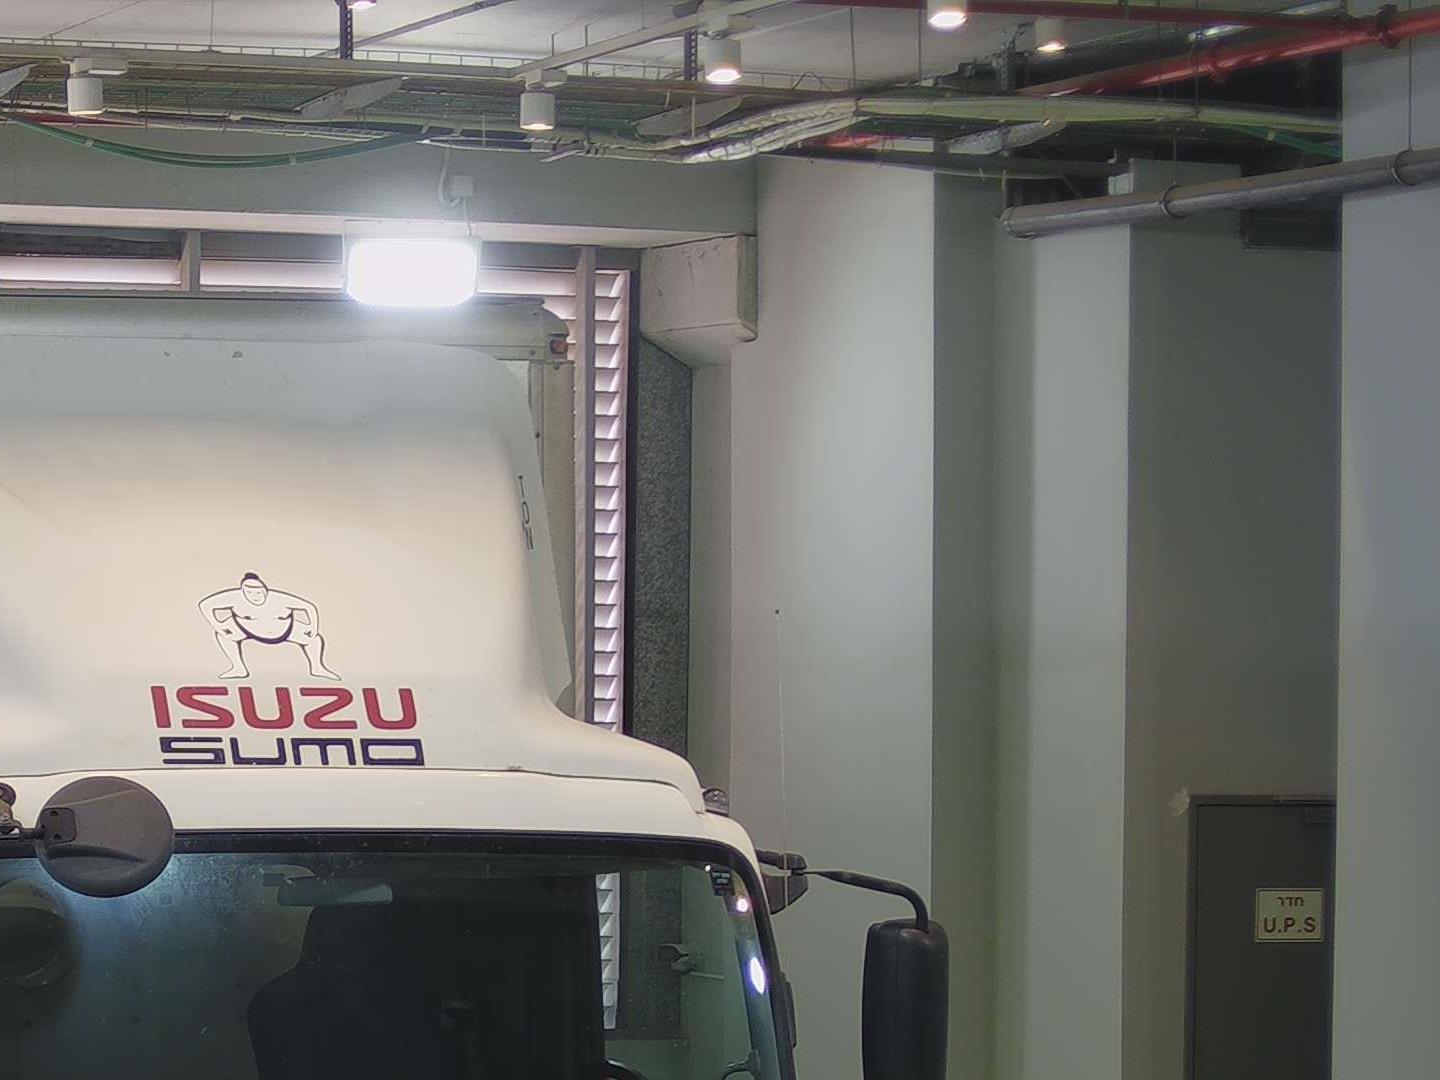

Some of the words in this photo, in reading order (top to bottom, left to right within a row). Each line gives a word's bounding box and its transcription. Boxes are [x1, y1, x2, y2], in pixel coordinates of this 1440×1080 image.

[150, 685, 418, 730] ISUZU
[159, 736, 425, 767] SUMO
[1275, 896, 1304, 907] חדר
